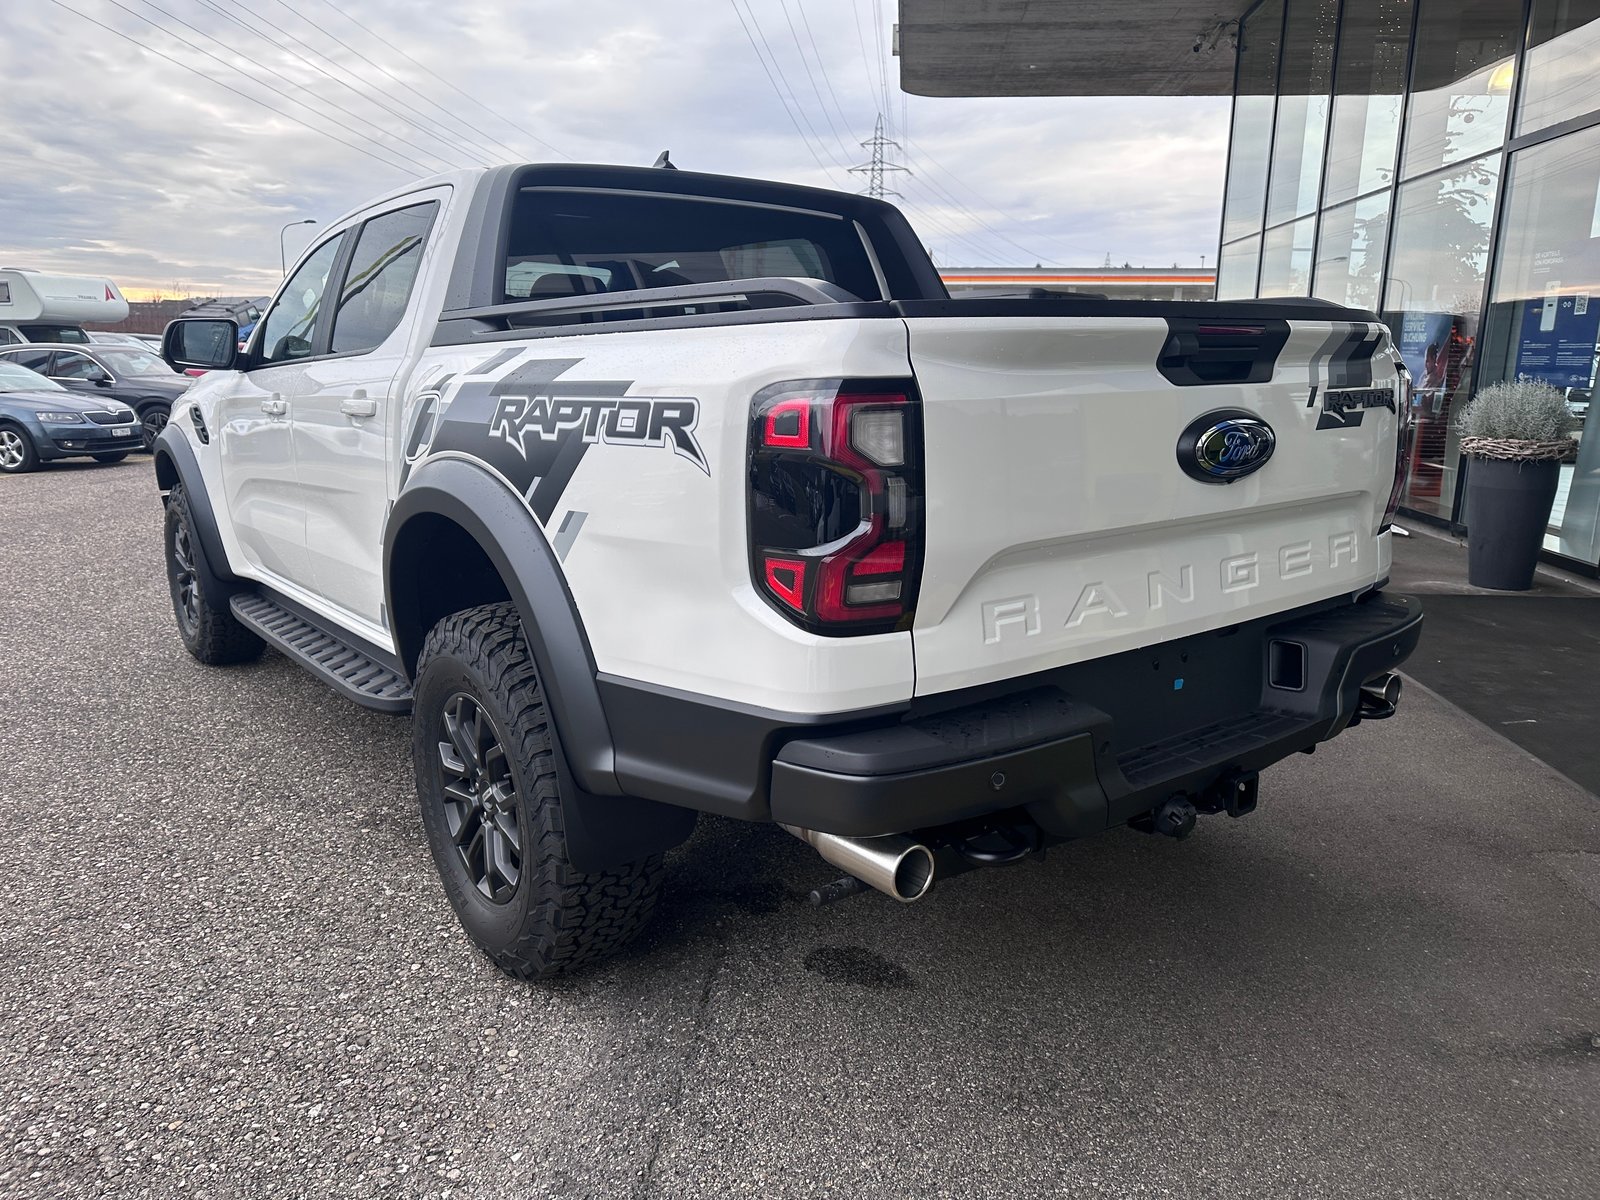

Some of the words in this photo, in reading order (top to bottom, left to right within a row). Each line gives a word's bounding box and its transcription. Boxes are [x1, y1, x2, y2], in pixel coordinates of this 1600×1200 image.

[1404, 321, 1426, 332] SERVICE
[1323, 388, 1396, 423] RAPTOR
[489, 396, 711, 477] RAPTOR
[1219, 431, 1262, 463] Ford
[981, 530, 1359, 645] RANGER
